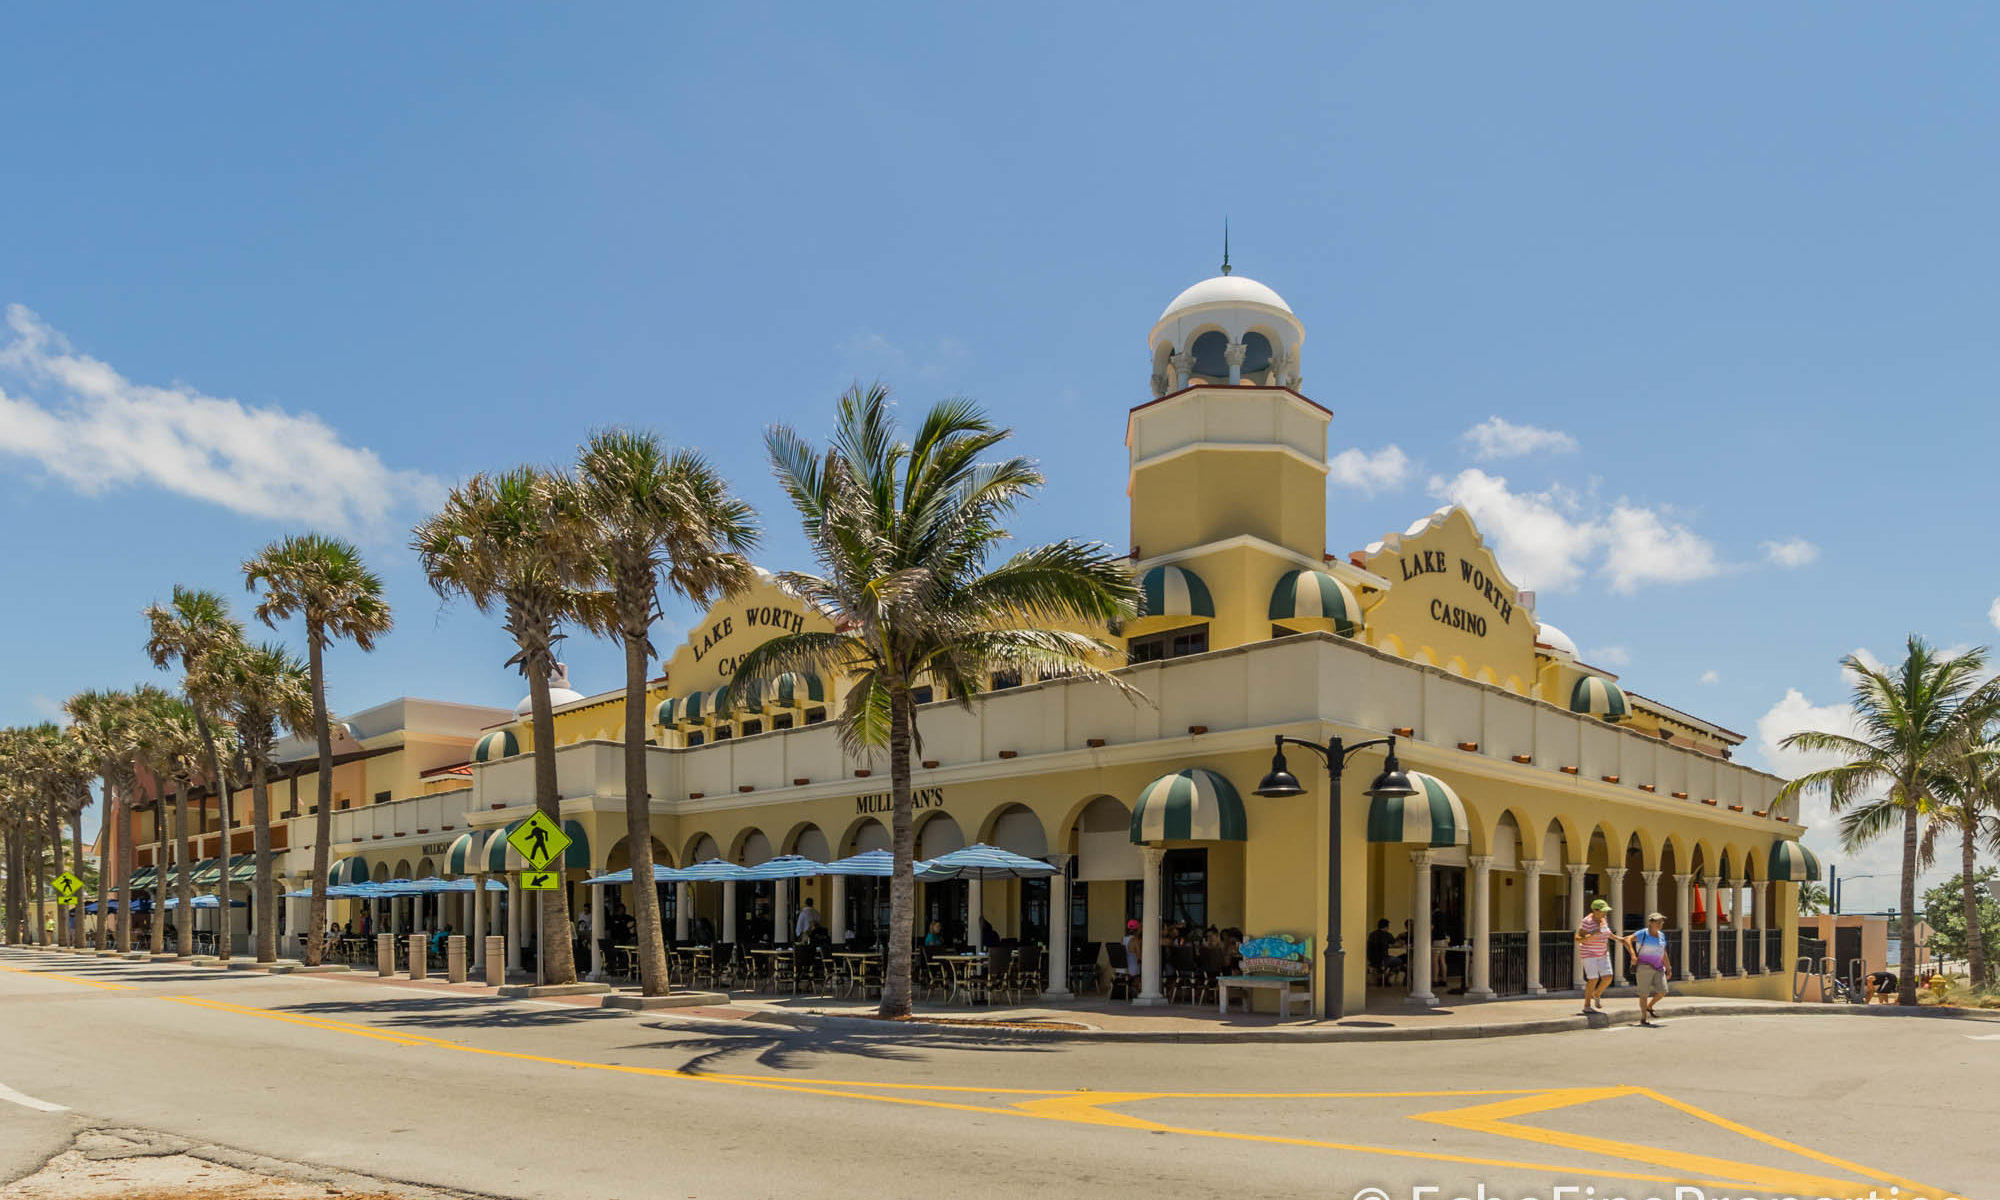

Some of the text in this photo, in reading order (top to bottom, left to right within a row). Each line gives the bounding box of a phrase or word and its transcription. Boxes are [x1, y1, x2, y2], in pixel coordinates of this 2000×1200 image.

[1400, 550, 1513, 624] LAKE WORTH
[693, 607, 804, 662] LAKE WORTH
[1430, 599, 1487, 637] CASINO
[856, 787, 944, 814] MULLAN'S
